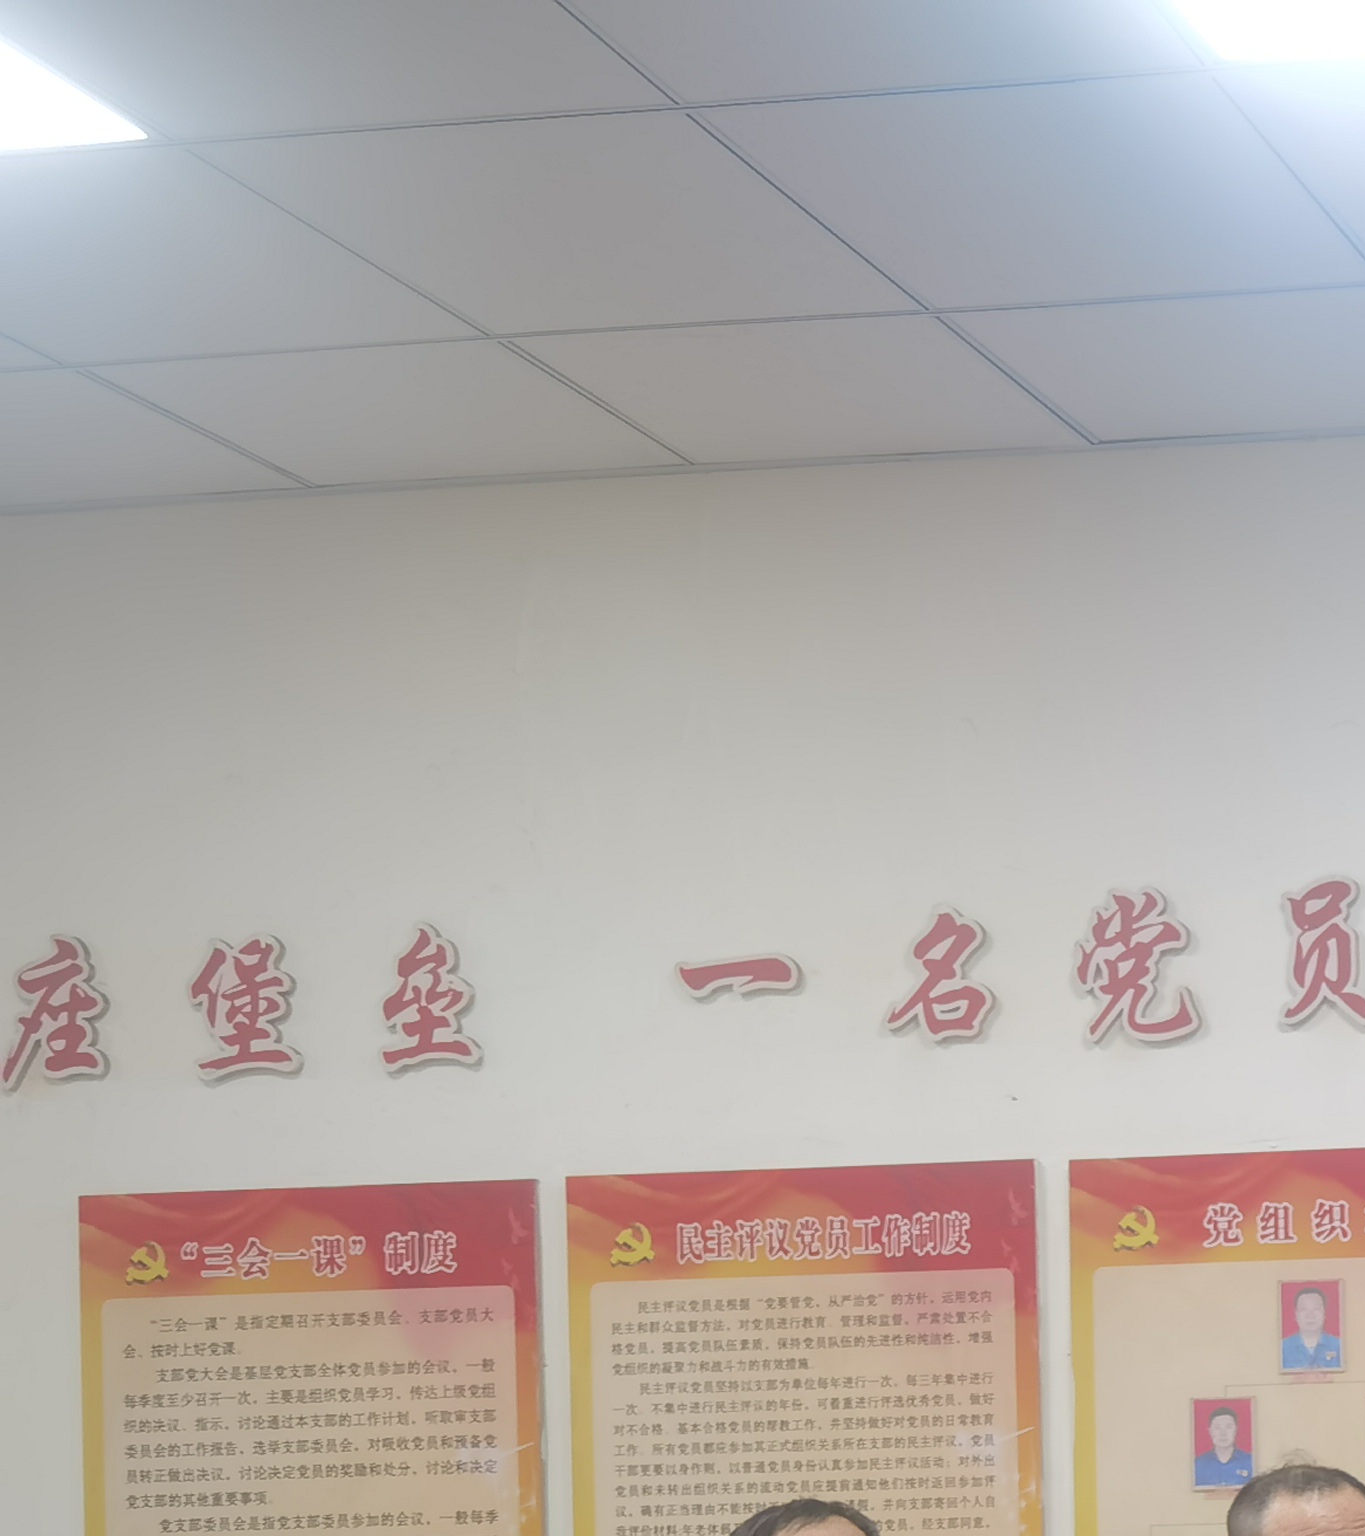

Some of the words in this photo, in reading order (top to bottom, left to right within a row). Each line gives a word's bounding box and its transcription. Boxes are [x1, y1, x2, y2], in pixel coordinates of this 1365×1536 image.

[676, 1210, 972, 1265] 民主评议党员工作制度
